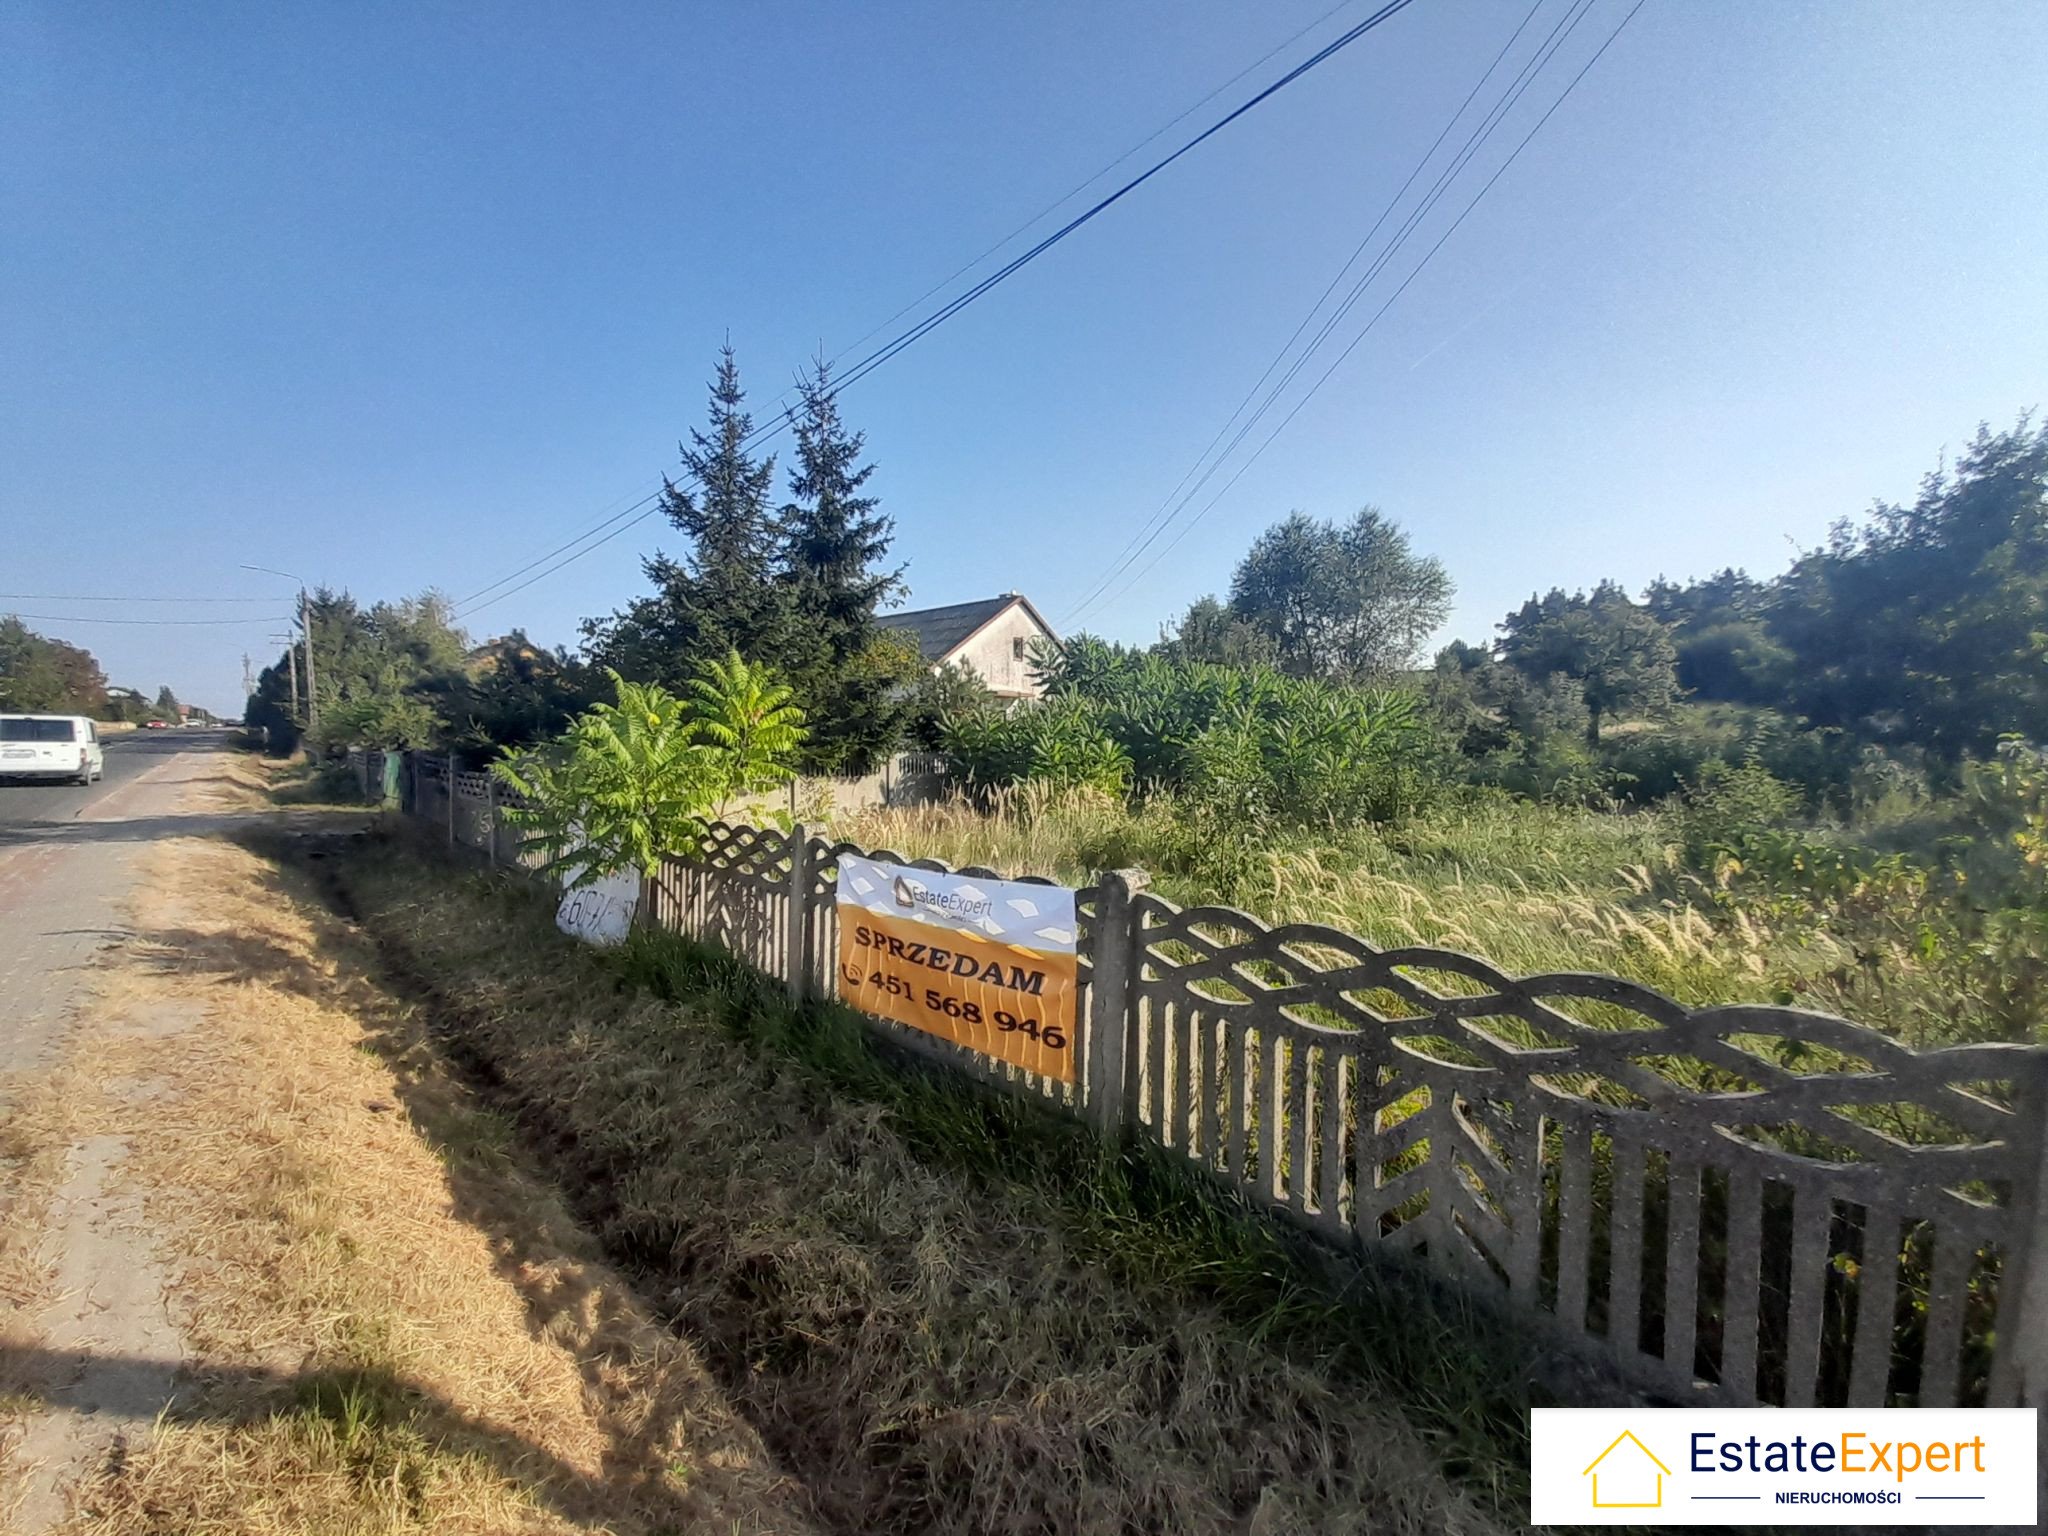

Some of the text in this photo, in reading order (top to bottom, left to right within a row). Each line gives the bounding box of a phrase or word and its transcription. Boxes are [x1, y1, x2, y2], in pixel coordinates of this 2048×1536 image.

[912, 886, 993, 917] EstateExpert
[855, 926, 1045, 996] SPRZEDAM
[869, 971, 1067, 1050] 451 568 946
